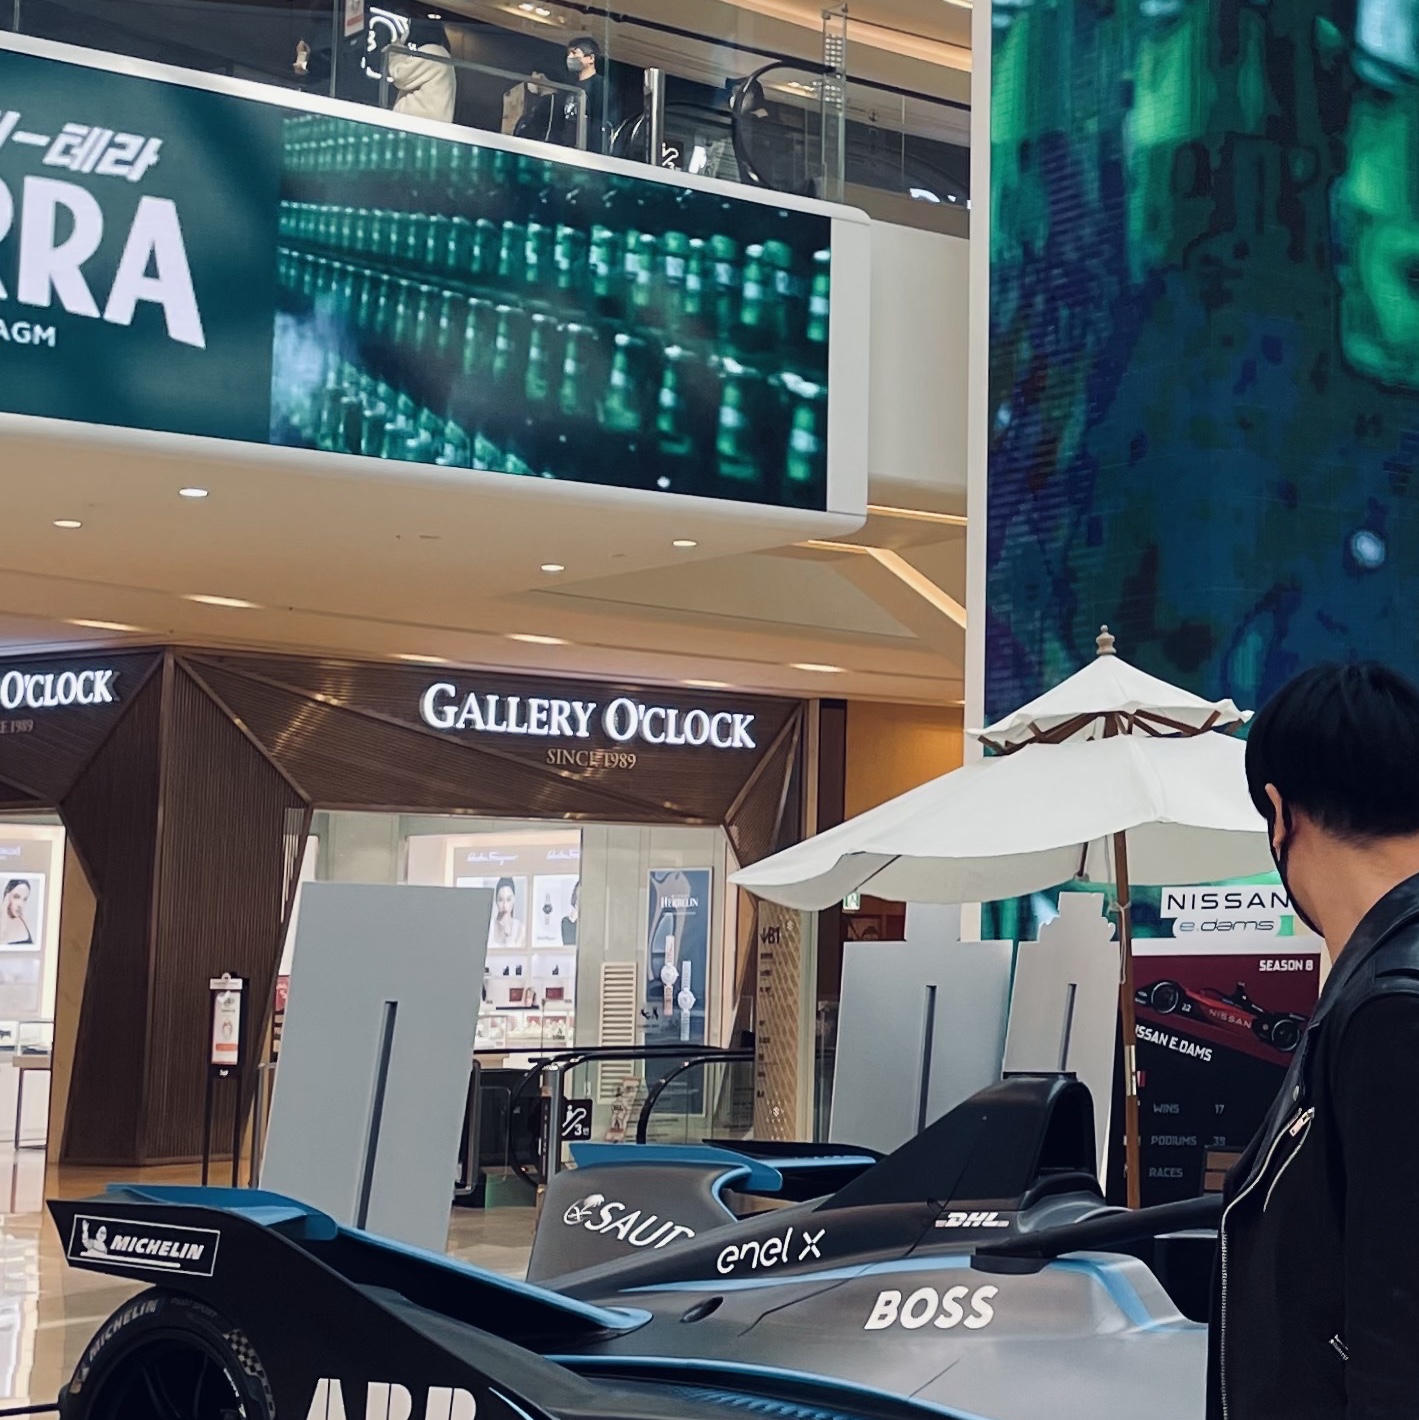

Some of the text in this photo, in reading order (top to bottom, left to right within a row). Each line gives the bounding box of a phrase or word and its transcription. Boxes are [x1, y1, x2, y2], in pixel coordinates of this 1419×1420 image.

[0, 174, 206, 349] RA
[0, 670, 114, 709] O'CLOCK
[604, 697, 757, 749] O'CLOCK
[547, 749, 637, 769] SINCE 1989
[1167, 892, 1290, 911] NISSAN
[1179, 918, 1274, 932] e.dams
[1259, 959, 1314, 972] SEASON 8
[1208, 1008, 1252, 1030] NISSAN
[1135, 1024, 1169, 1047] ISSAN
[1153, 1103, 1225, 1115] WINS 17
[1151, 1135, 1197, 1147] PODIUMS
[1149, 1167, 1183, 1178] RACES
[940, 1212, 1006, 1228] DHL
[110, 1234, 205, 1261] MICHELIN
[716, 1227, 793, 1274] enel
[863, 1284, 999, 1331] BOSS
[90, 1299, 159, 1363] MICHELIN
